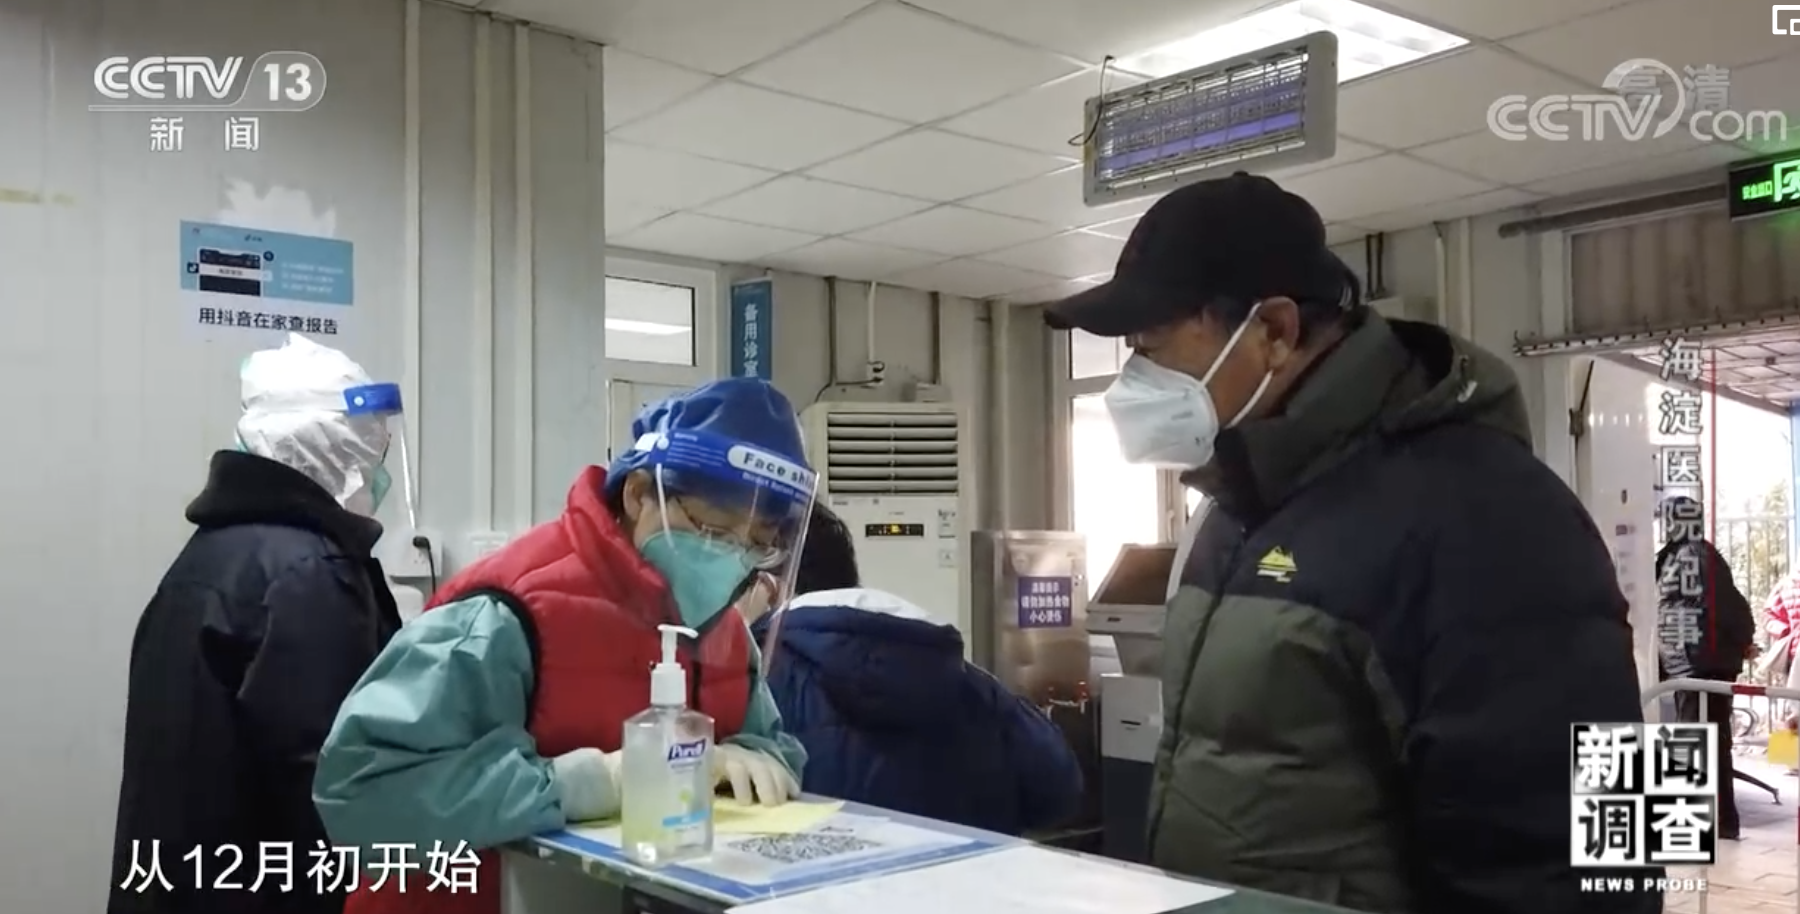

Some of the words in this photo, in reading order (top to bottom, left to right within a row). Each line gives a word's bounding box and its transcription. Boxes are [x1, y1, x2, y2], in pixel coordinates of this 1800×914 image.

[199, 307, 338, 335] 用抖音在家查报告
[744, 303, 758, 377] 备用诊室
[743, 452, 785, 475] Face
